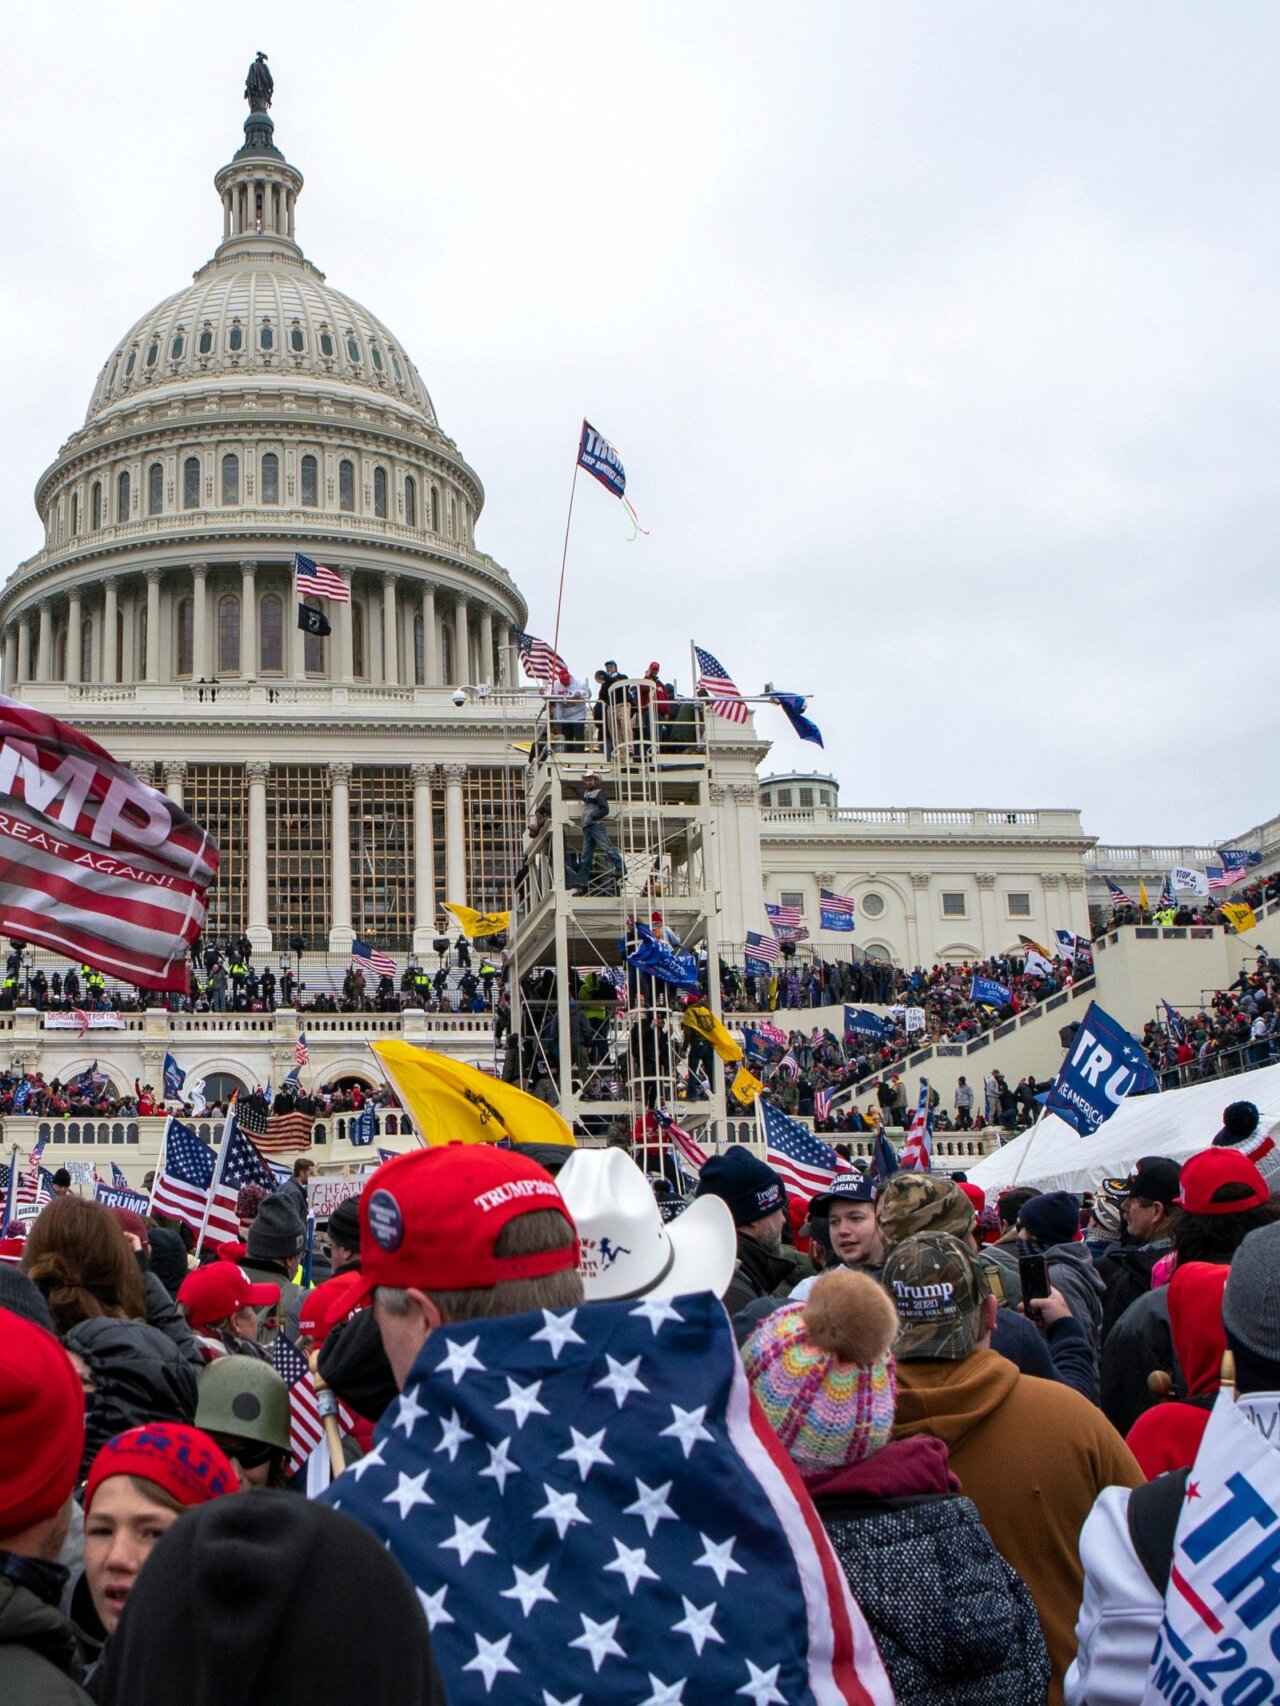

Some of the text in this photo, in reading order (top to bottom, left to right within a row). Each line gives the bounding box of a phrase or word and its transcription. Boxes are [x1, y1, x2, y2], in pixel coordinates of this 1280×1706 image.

[77, 852, 176, 888] AGAIN!
[978, 979, 1010, 996] TRUMP
[47, 1013, 73, 1021] GEORGIA
[92, 1013, 105, 1021] FOR
[849, 1024, 882, 1038] LIBERTY
[1067, 1086, 1104, 1125] AMERICA
[67, 1163, 90, 1172] SEND
[755, 1183, 779, 1200] Trump
[835, 1183, 858, 1192] AGAIN
[99, 1190, 148, 1214] TRUMP
[19, 1206, 39, 1215] BIKERS
[893, 1280, 953, 1301] Trump
[913, 1300, 938, 1309] 2020
